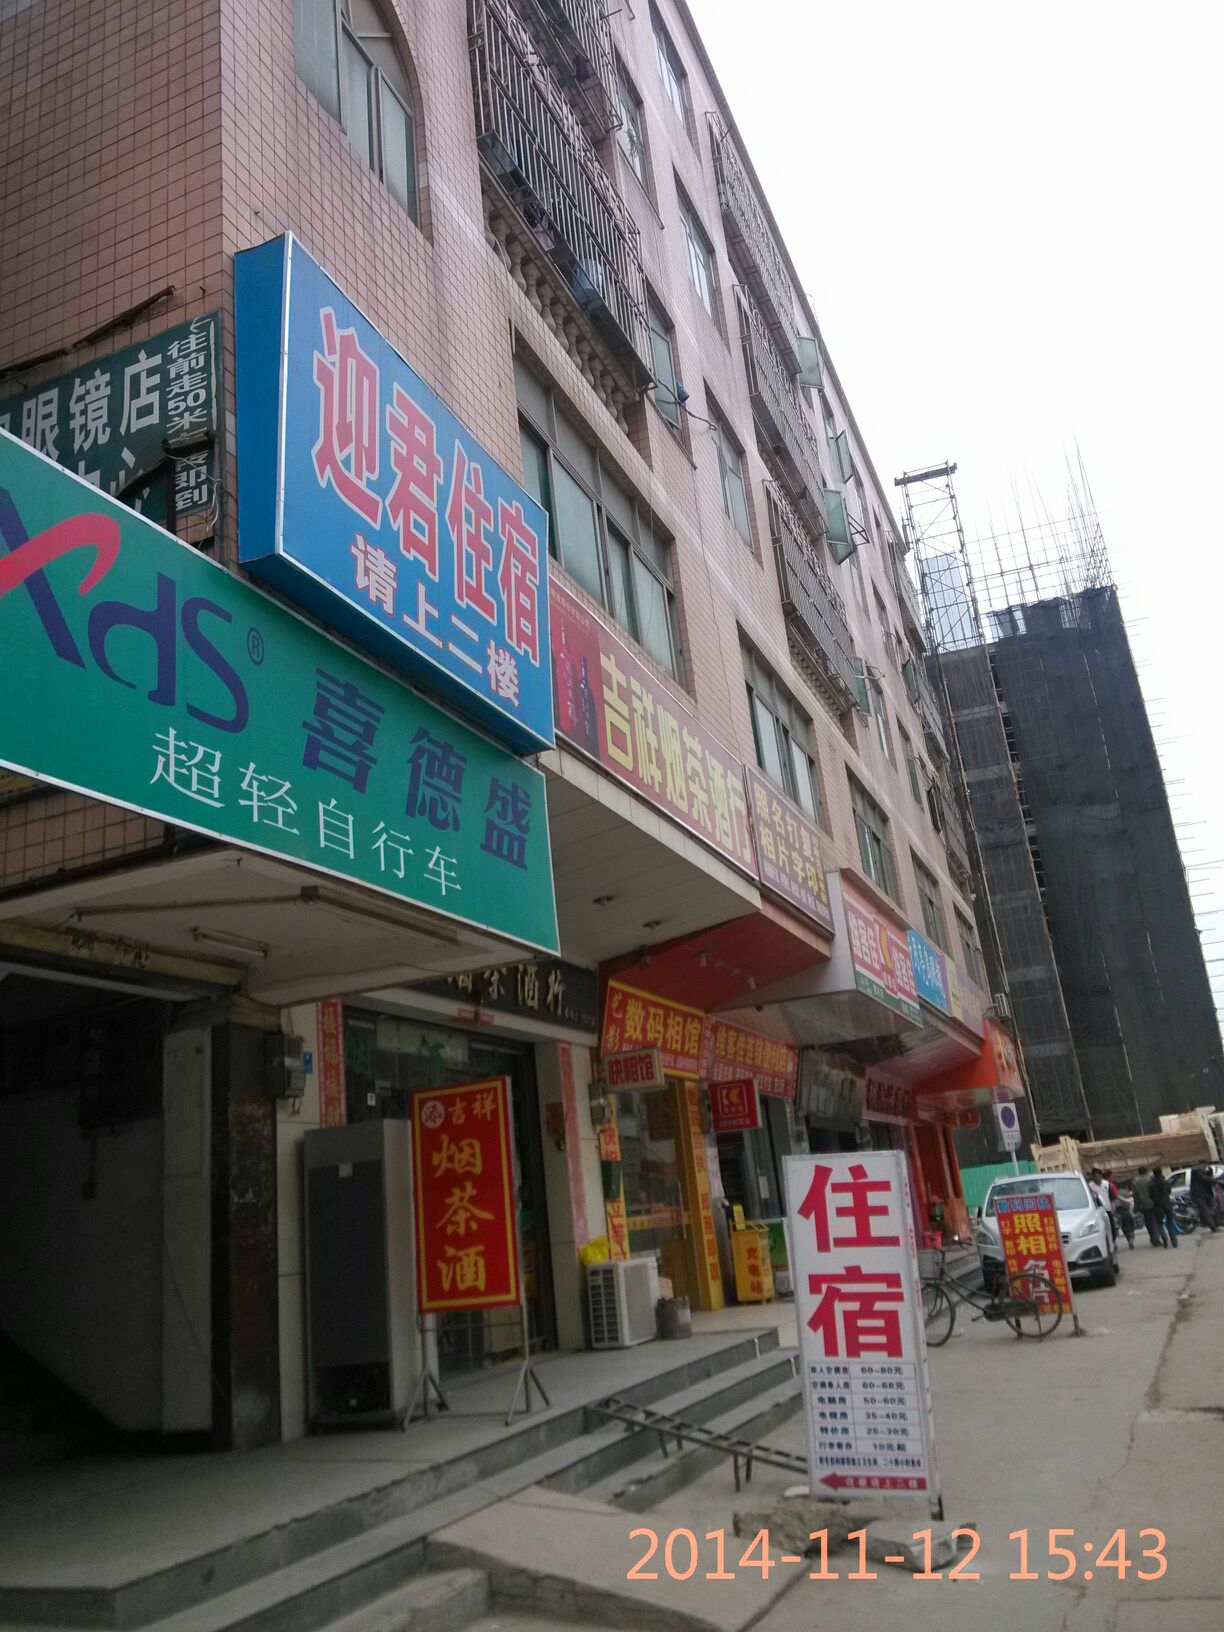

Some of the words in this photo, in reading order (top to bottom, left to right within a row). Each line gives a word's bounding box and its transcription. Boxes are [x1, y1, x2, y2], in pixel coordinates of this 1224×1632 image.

[0, 349, 162, 460] 眼镜店
[312, 305, 539, 667] 迎君住宿
[351, 533, 521, 708] 请上二楼
[150, 727, 463, 897] 超轻自行车
[302, 667, 532, 871] 喜德盛
[600, 651, 753, 864] 吉祥烟茶酒行
[448, 1090, 497, 1125] 吉祥
[624, 998, 700, 1056] 数码相馆
[431, 1134, 496, 1292] 烟茶酒
[797, 1164, 905, 1359] 住宿
[1013, 1213, 1047, 1256] 照相
